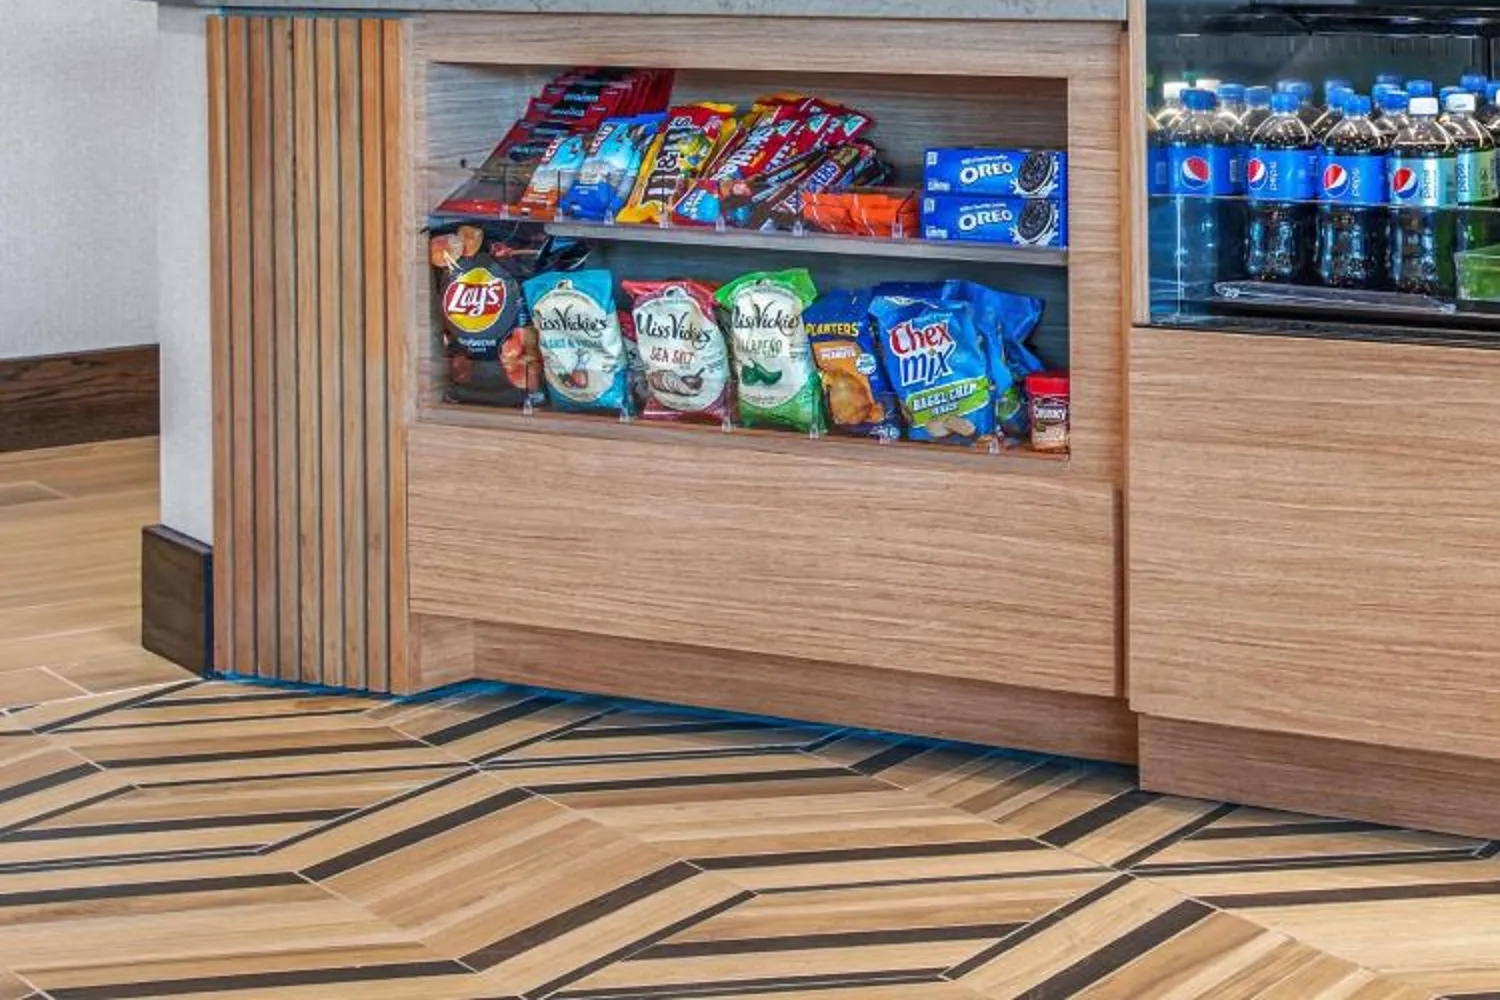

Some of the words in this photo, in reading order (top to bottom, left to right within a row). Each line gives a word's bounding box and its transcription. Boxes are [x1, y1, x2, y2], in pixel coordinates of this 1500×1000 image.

[959, 161, 1014, 184] OREO
[958, 209, 1014, 231] OREO
[448, 277, 502, 317] Lay's
[805, 321, 859, 337] PLANTERS
[889, 320, 954, 356] Chex
